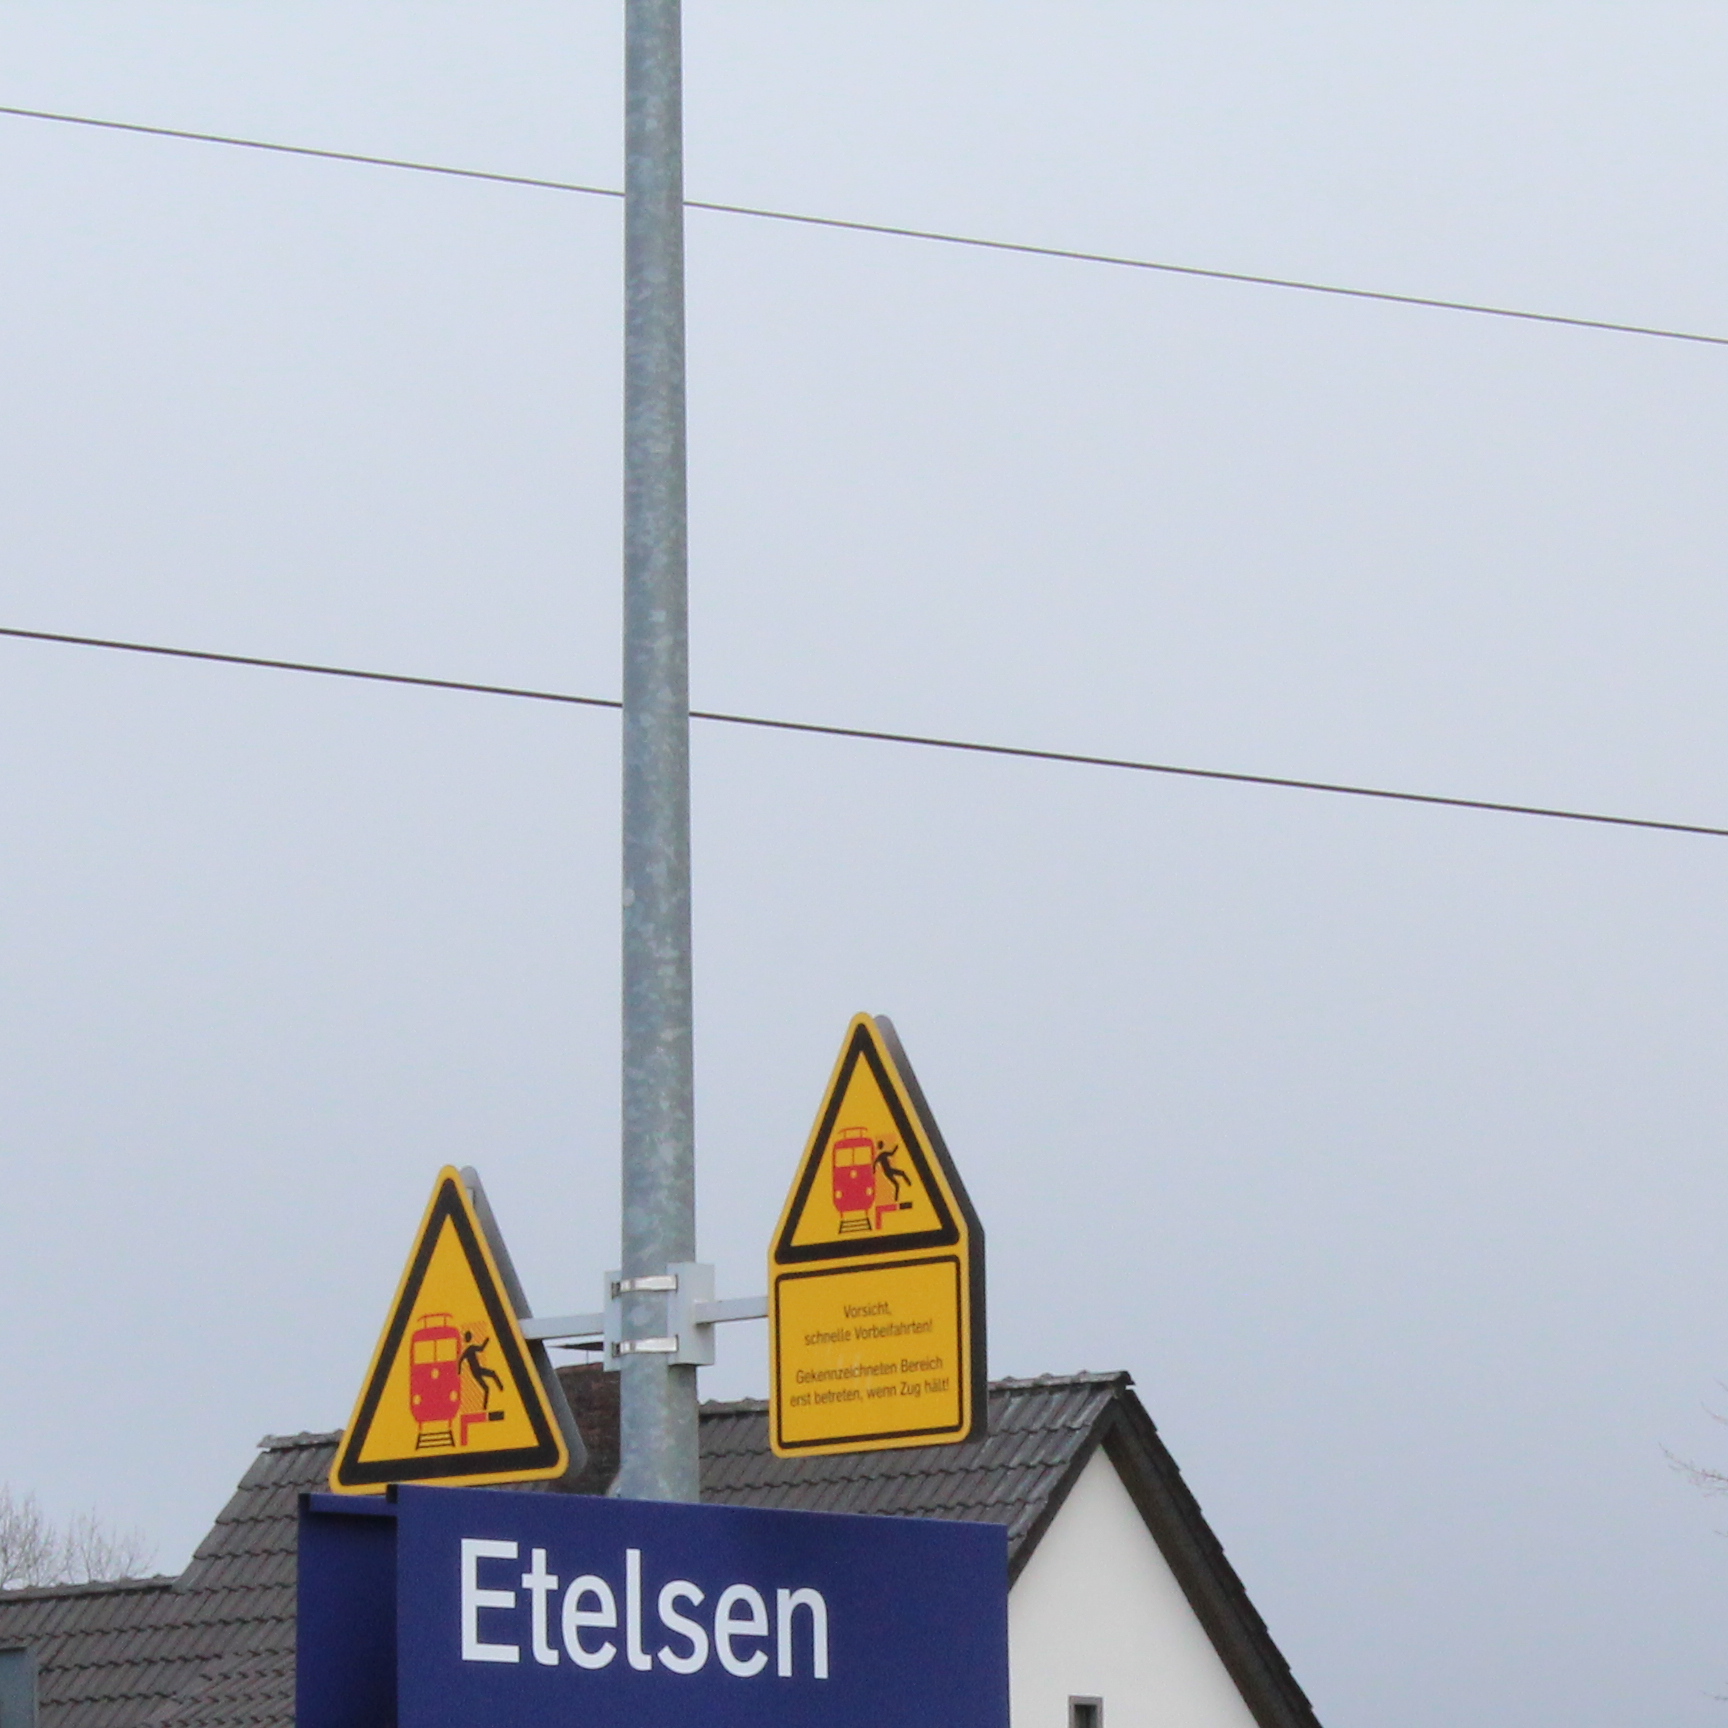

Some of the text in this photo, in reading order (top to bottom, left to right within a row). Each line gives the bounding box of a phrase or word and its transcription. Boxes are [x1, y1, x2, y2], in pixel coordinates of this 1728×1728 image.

[844, 1302, 892, 1318] Vorsicht,
[804, 1321, 933, 1345] schnelle Vorbeifahrten!
[796, 1356, 943, 1384] Gekennzeichneten Bereich
[790, 1378, 949, 1407] erst betreten, wenn Zug hält!
[461, 1538, 829, 1680] Etelsen
